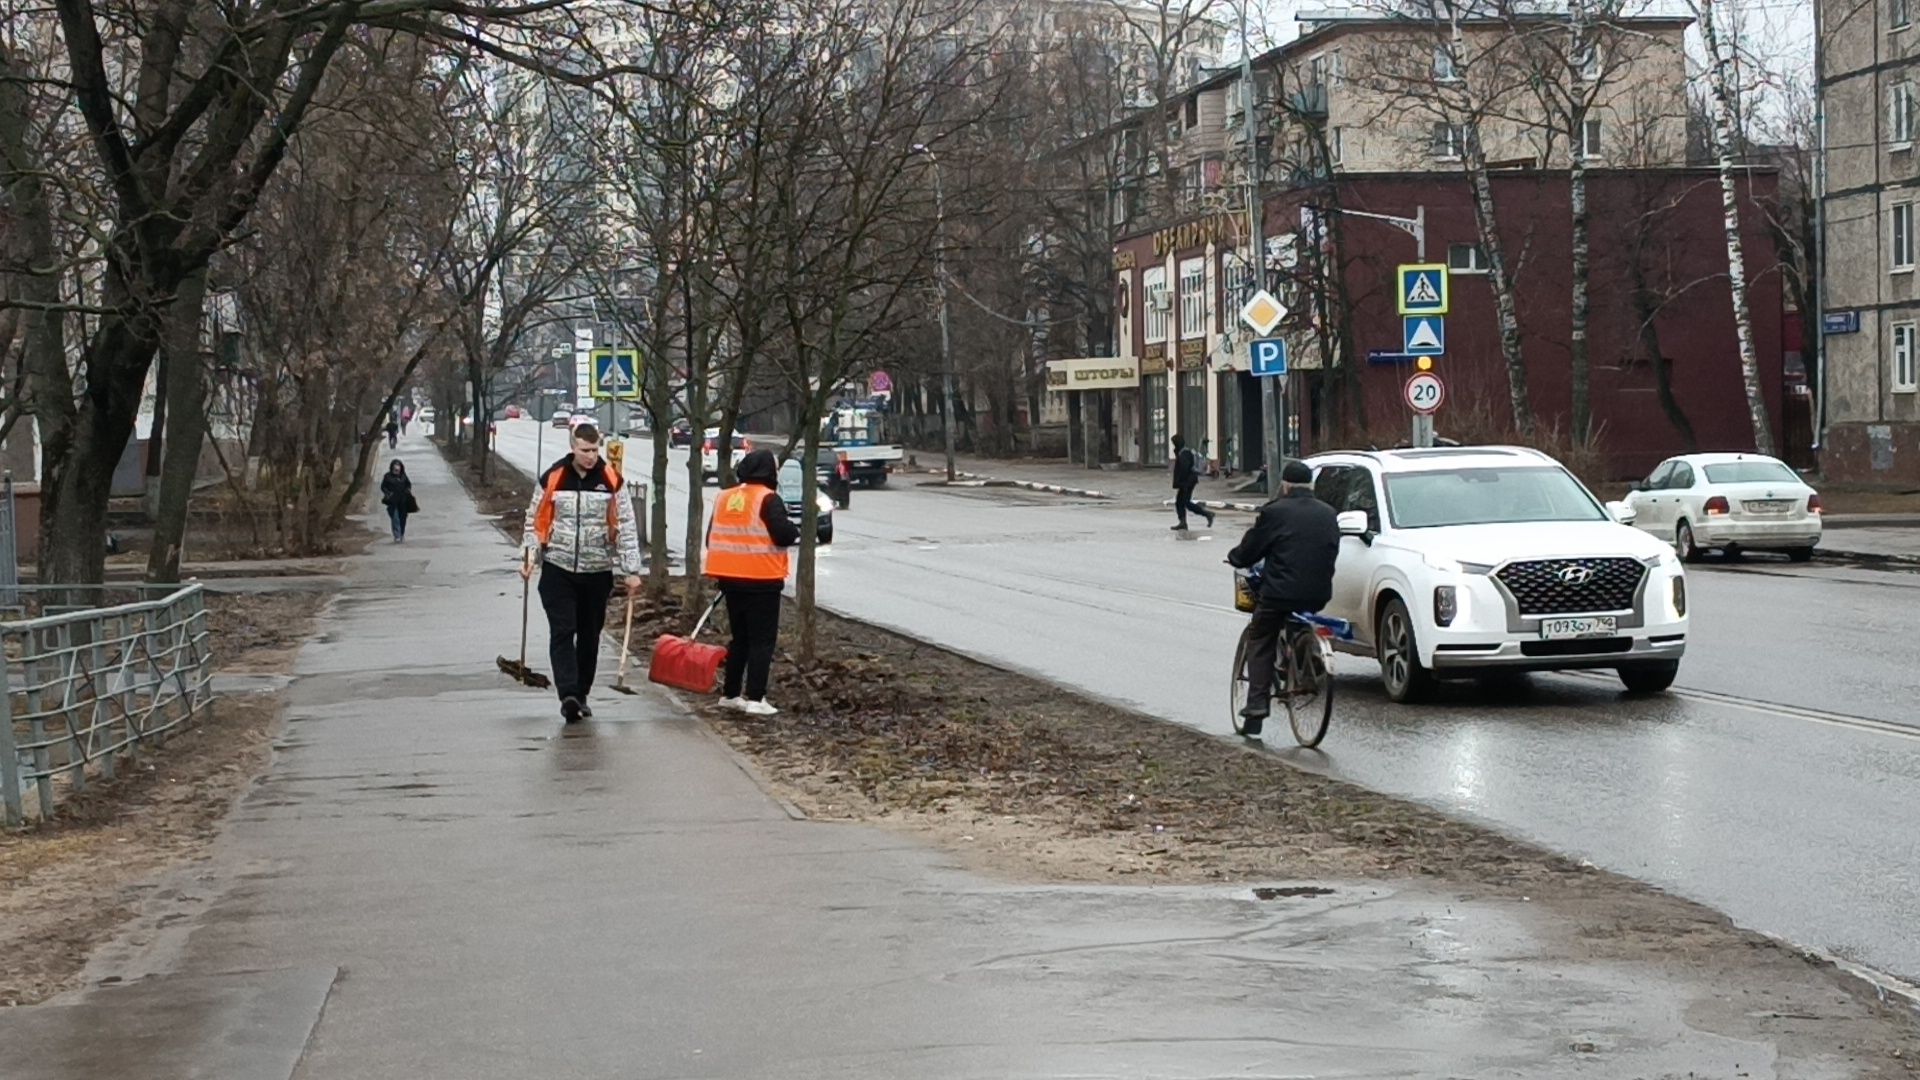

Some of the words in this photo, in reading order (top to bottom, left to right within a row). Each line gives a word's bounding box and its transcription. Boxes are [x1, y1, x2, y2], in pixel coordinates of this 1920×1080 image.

[1258, 343, 1278, 371] P
[1074, 367, 1134, 381] ШТОРЫ
[1413, 384, 1436, 401] 20
